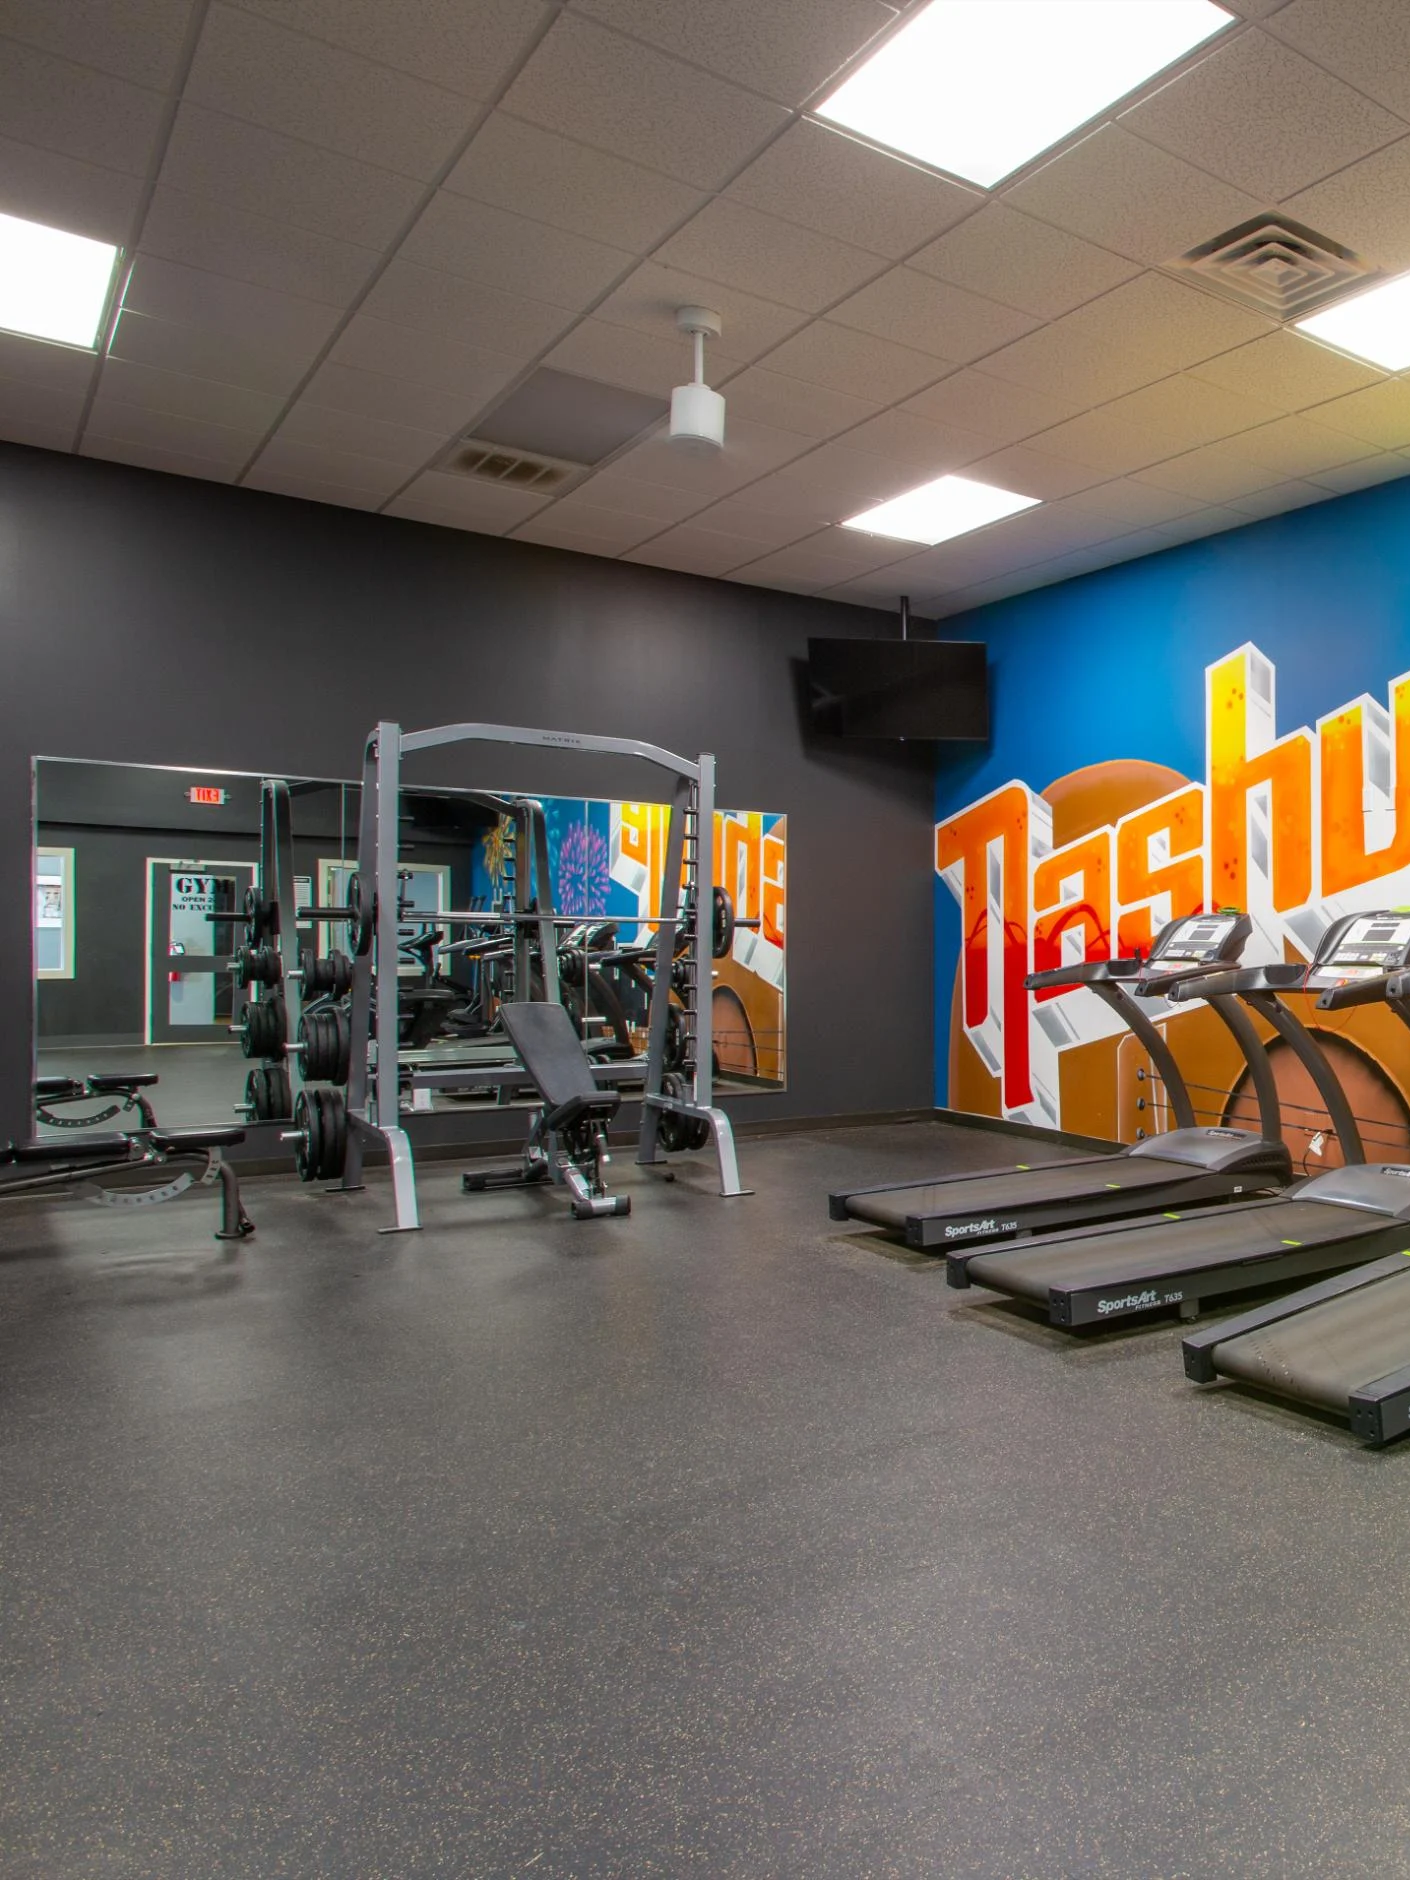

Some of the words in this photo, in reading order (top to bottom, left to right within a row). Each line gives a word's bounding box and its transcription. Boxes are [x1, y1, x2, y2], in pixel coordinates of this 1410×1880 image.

[172, 903, 187, 911] NO
[945, 1219, 996, 1238] SportsArt
[1097, 1289, 1158, 1315] SportsArt
[1164, 1291, 1184, 1304] T635
